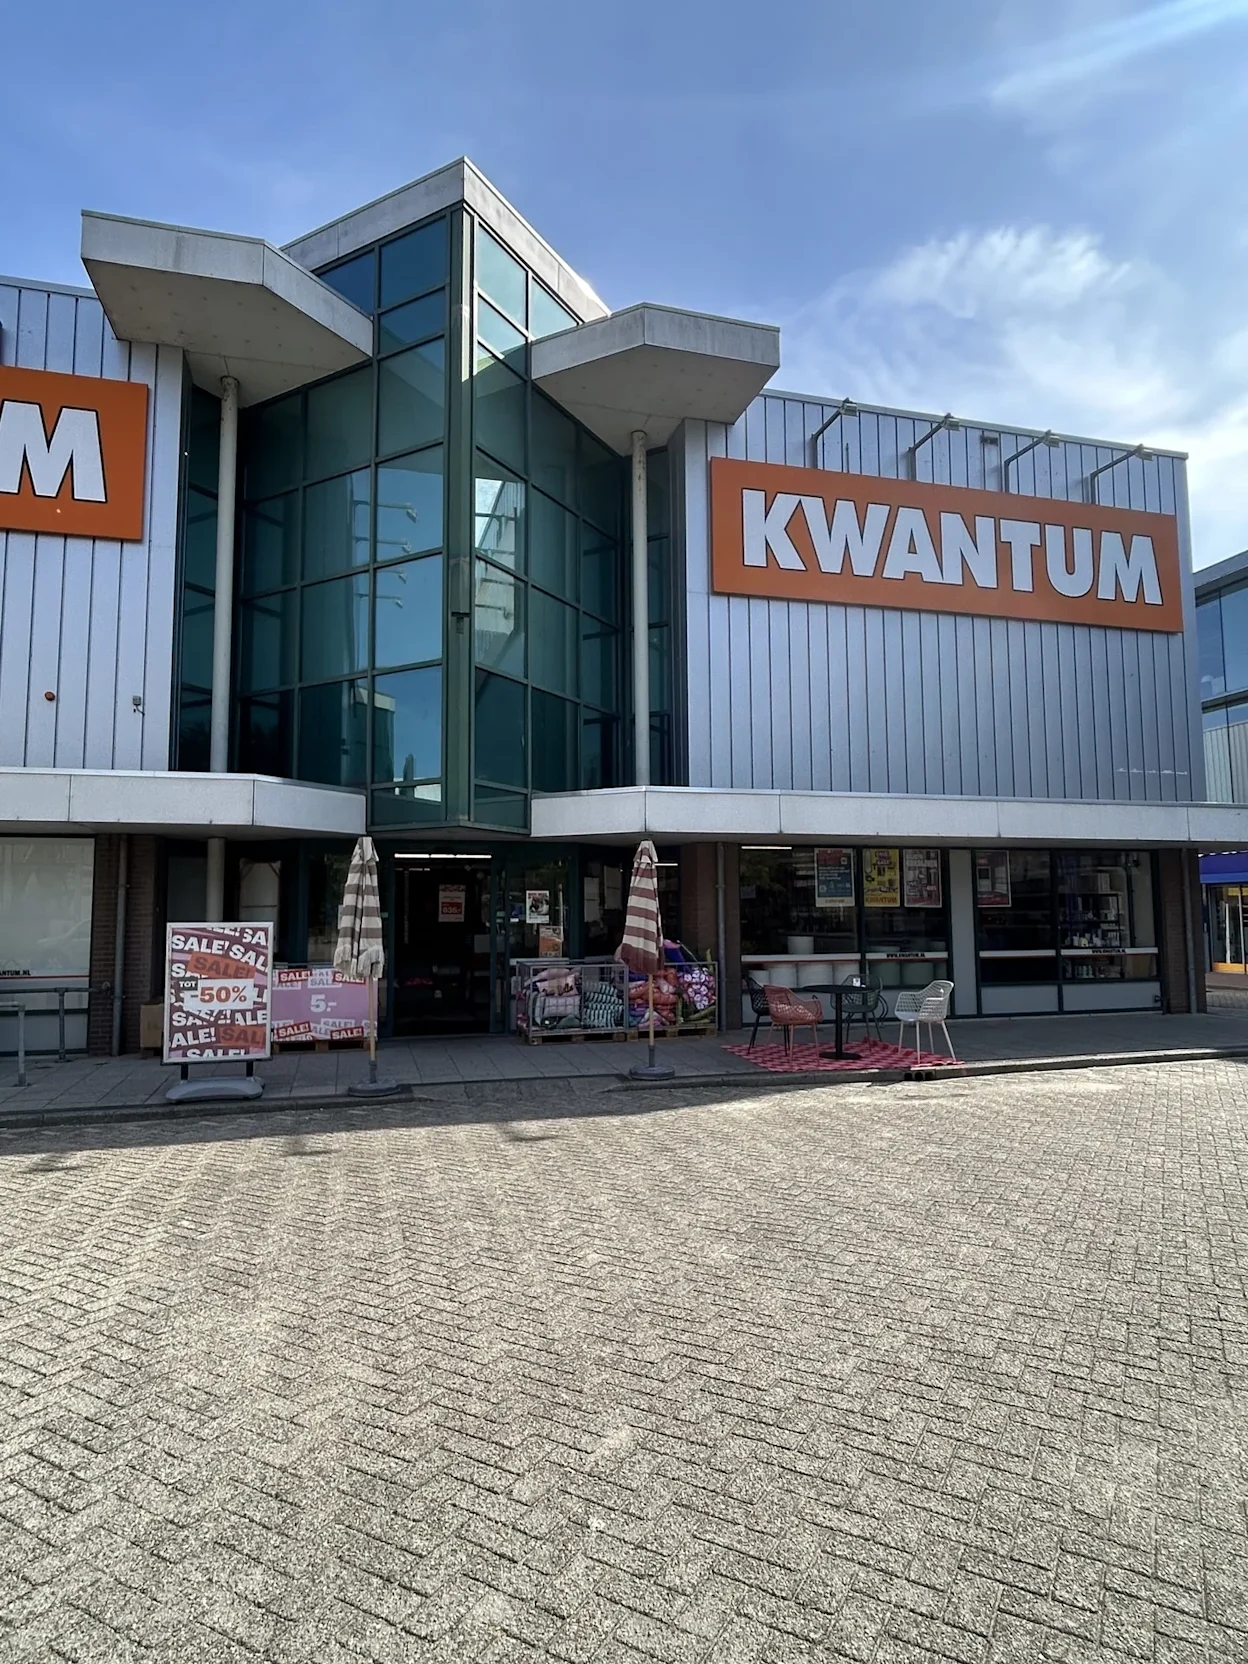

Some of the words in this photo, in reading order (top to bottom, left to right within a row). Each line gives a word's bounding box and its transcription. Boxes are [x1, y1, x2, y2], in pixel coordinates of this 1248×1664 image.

[0, 399, 108, 503] M
[741, 488, 1164, 606] KWANTUM
[172, 935, 230, 955] SALE!
[229, 944, 268, 973] SAL
[193, 956, 252, 978] SALE!
[280, 970, 311, 982] SALE!
[178, 980, 197, 988] TOT
[190, 985, 247, 1003] -50%
[310, 994, 337, 1013] 5.-
[221, 1027, 266, 1044] SAL
[279, 1022, 310, 1038] SALE!
[332, 1027, 363, 1040] SALE!
